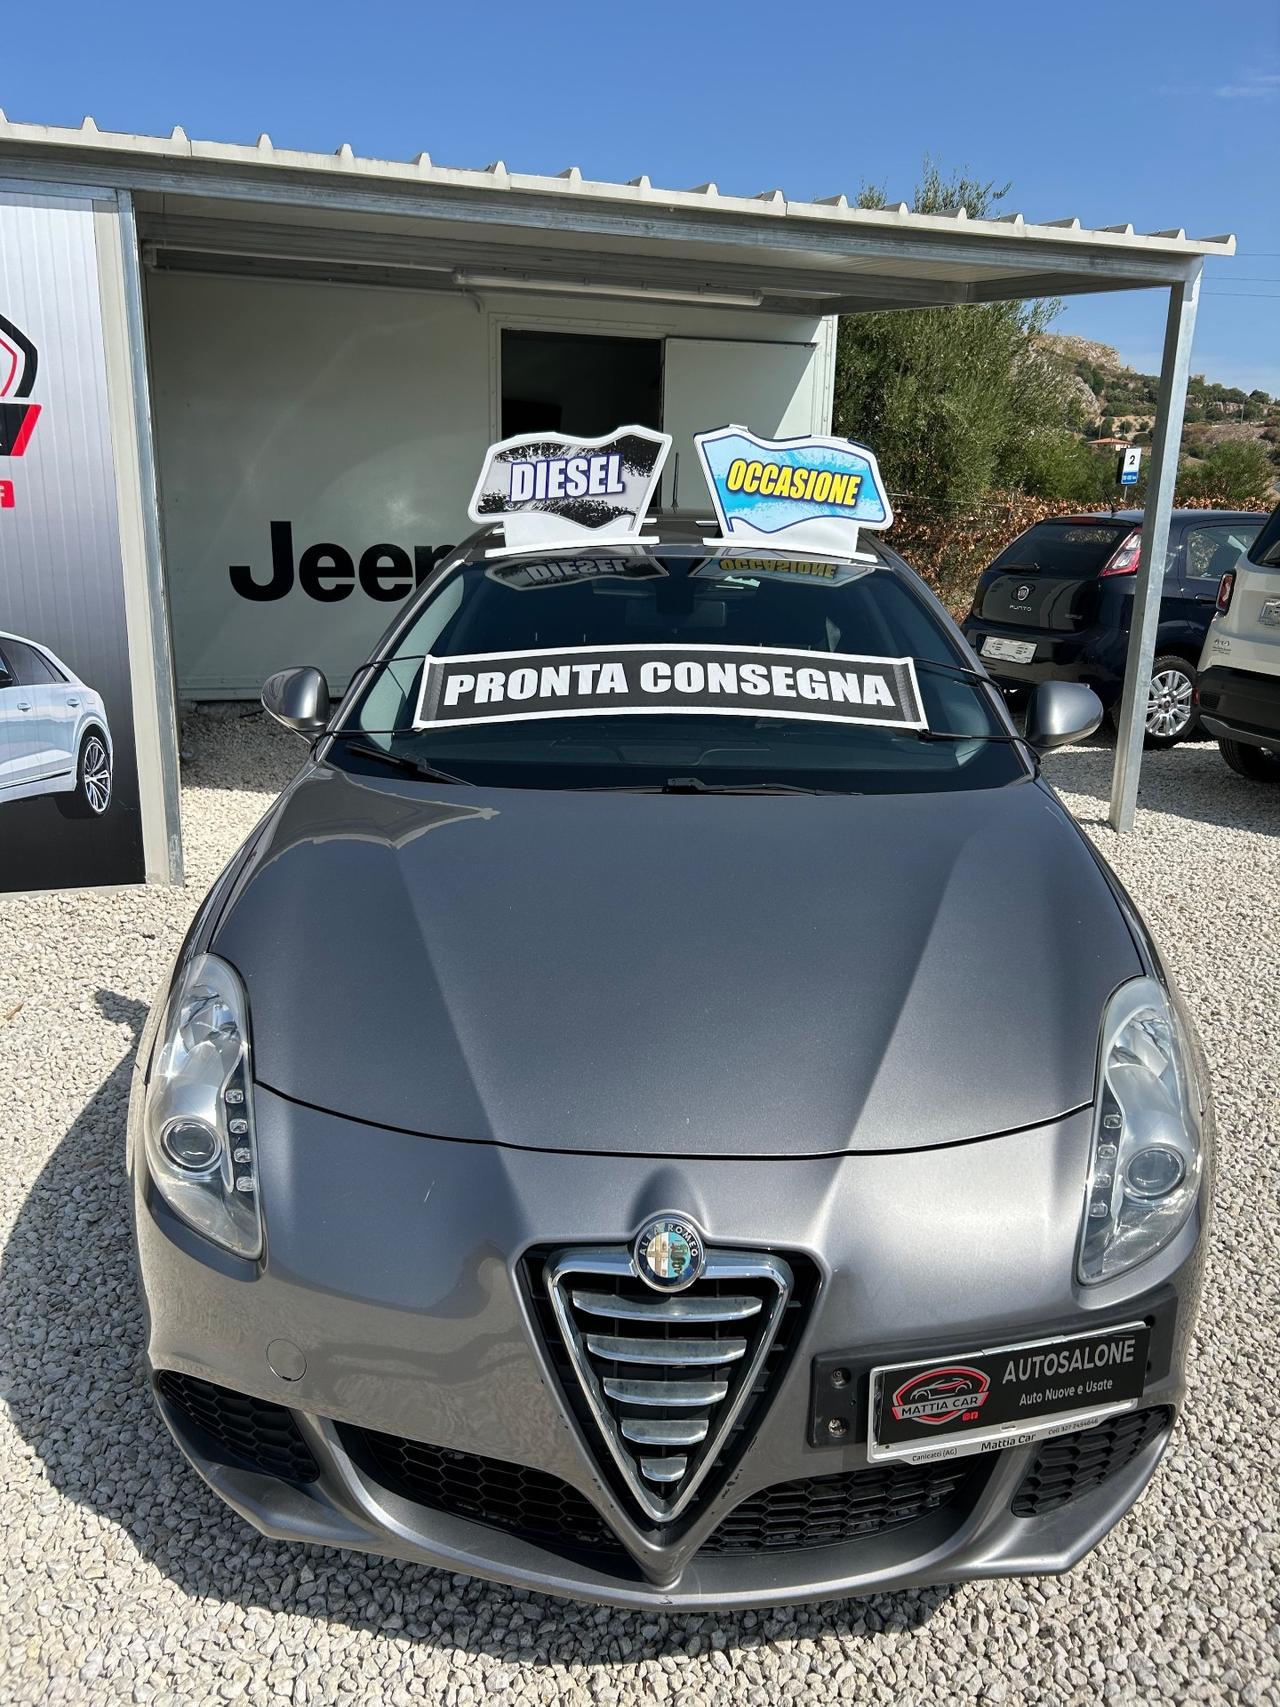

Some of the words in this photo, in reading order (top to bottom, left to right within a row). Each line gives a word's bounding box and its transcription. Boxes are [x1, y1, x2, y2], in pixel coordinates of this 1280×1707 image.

[1129, 455, 1136, 465] 2
[510, 453, 625, 501] DIESEL
[726, 459, 862, 506] OCCASIONE
[1009, 604, 1032, 612] PUNTO
[444, 662, 630, 706] PRONTA
[640, 661, 896, 707] CONSEGNA
[667, 1223, 699, 1257] ROMEO
[1002, 1339, 1136, 1385] AUTOSALONE
[901, 1402, 948, 1417] MATTIA
[952, 1396, 979, 1408] CAR
[1019, 1393, 1043, 1407] Auto
[1045, 1386, 1075, 1401] Nuove
[1077, 1385, 1083, 1395] e
[1085, 1379, 1113, 1393] Usate
[980, 1438, 1016, 1452] Mattia
[1018, 1433, 1037, 1444] Car
